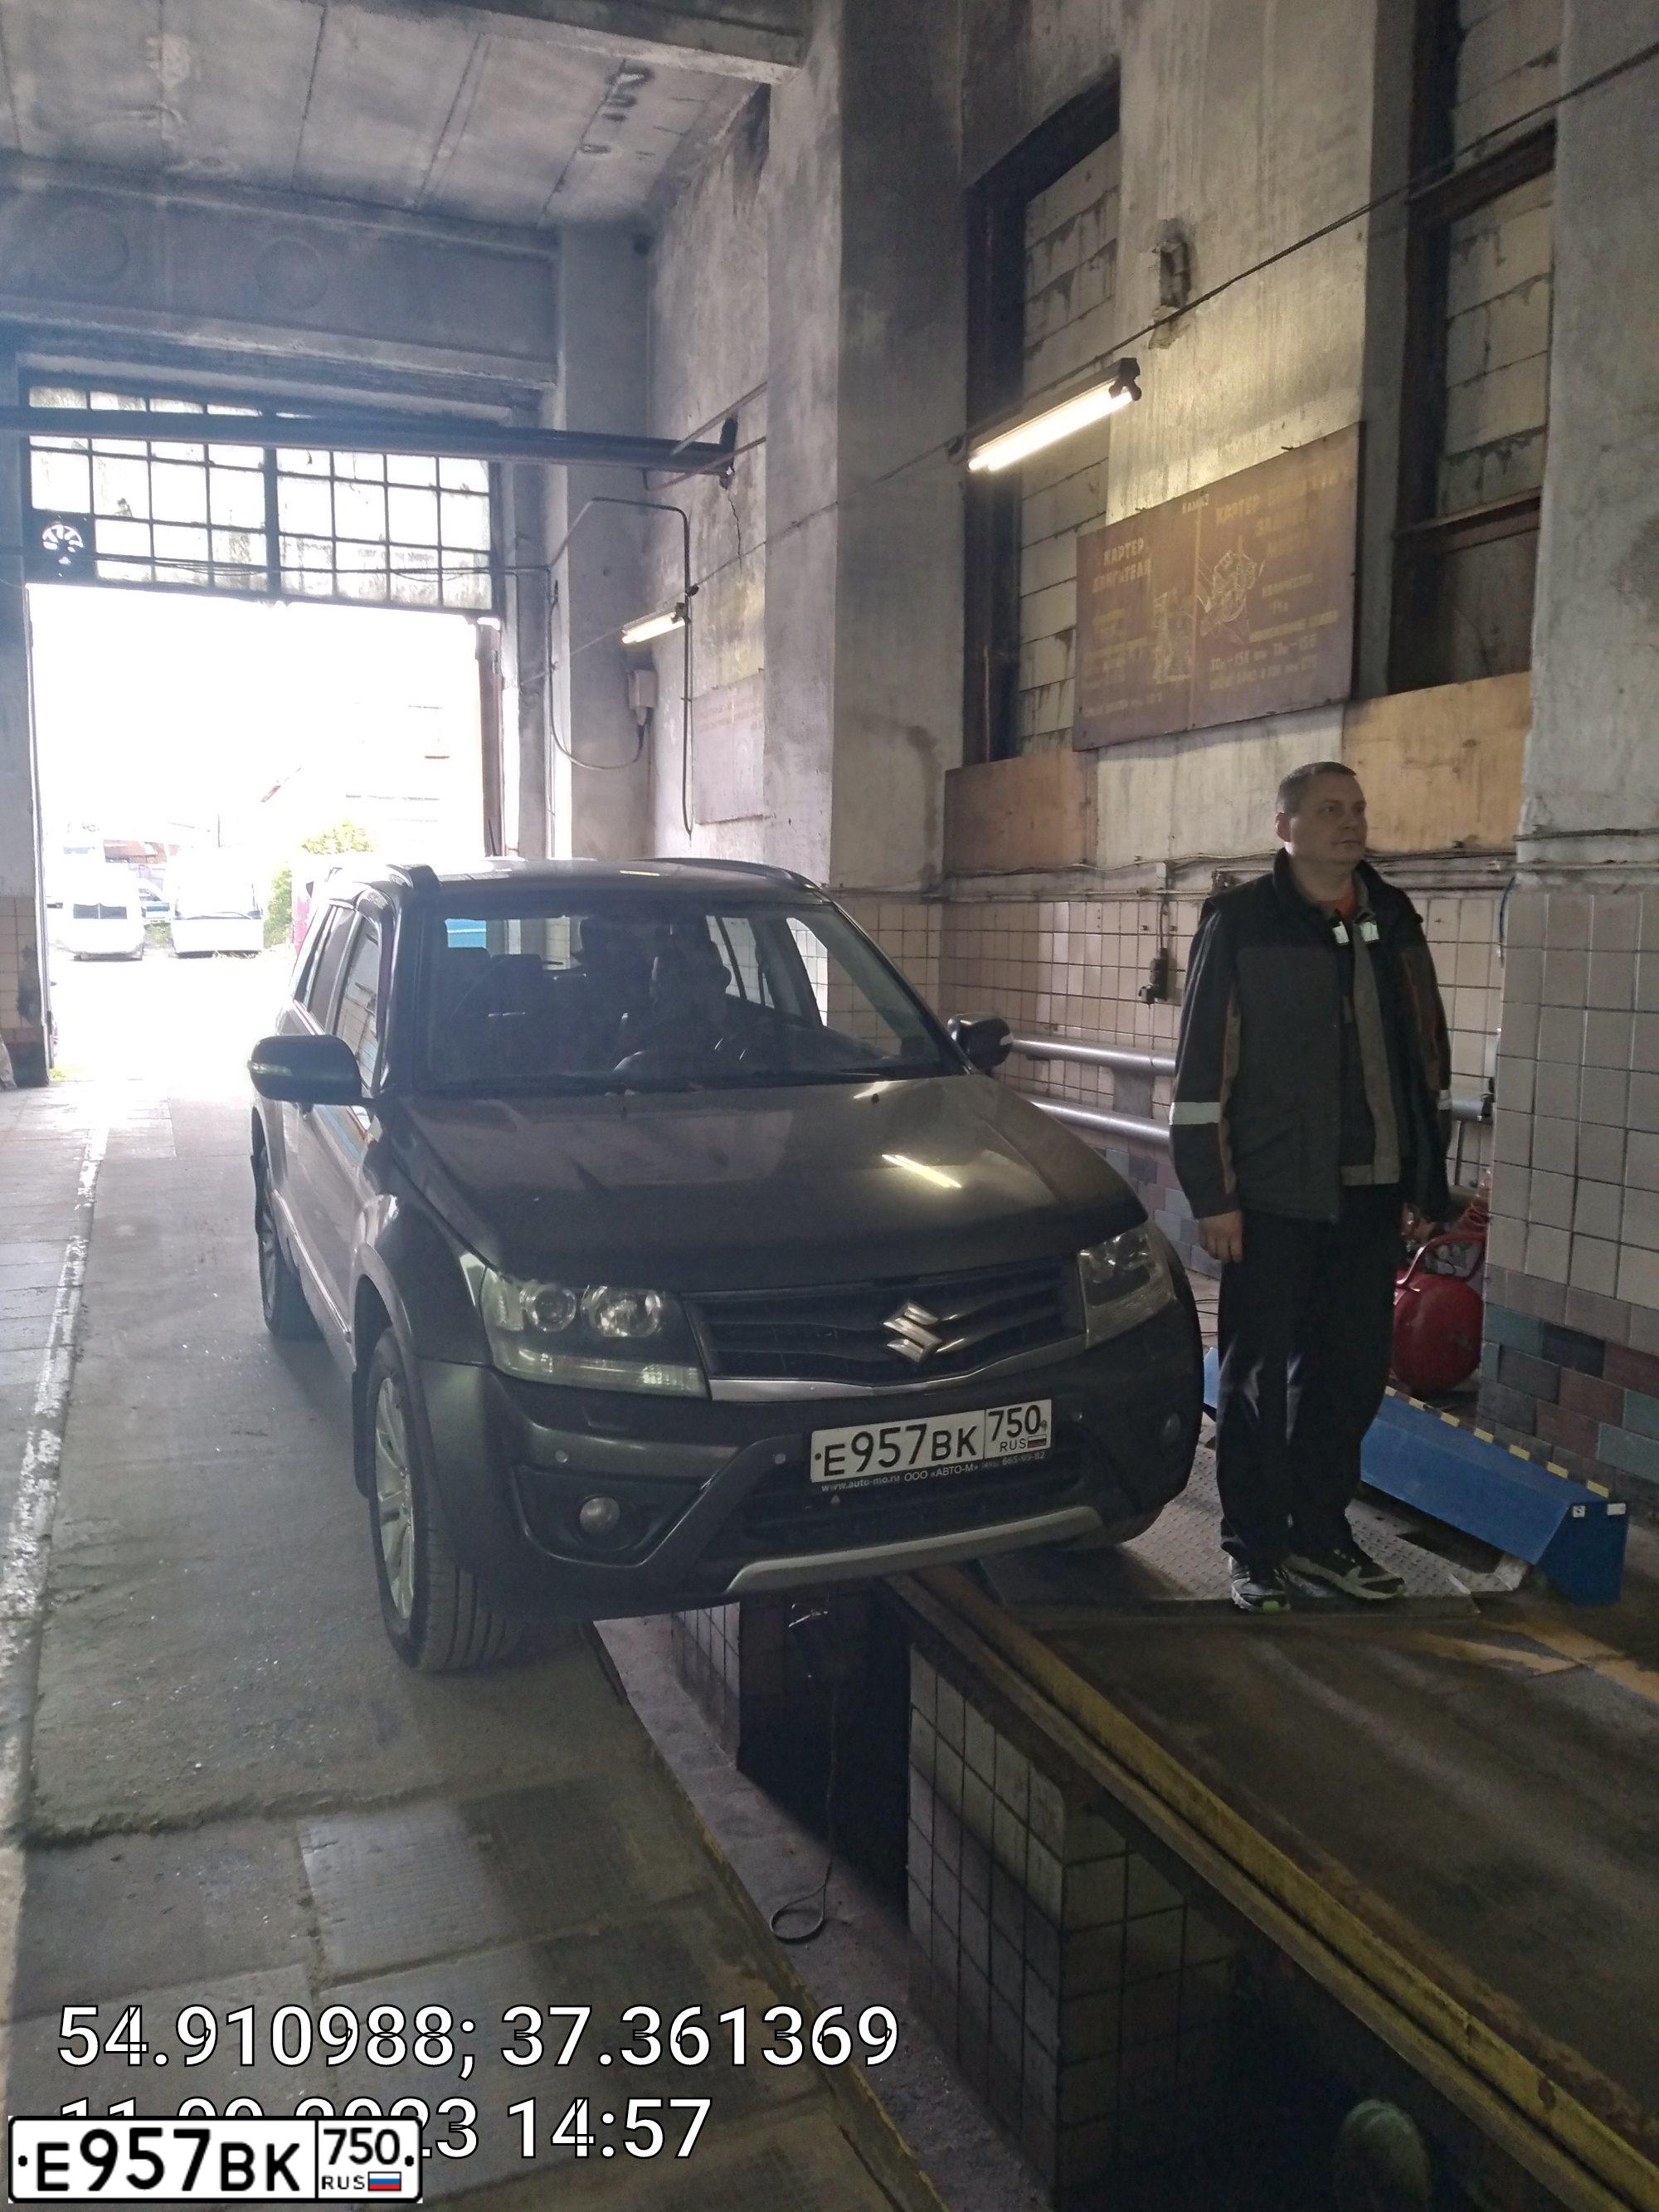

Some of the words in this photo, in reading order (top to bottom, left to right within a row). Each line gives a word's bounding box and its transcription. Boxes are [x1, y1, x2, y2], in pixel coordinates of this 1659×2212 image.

[824, 1423, 977, 1477] Е957ВК
[988, 1404, 1040, 1441] 750
[1000, 1440, 1026, 1453] RUS
